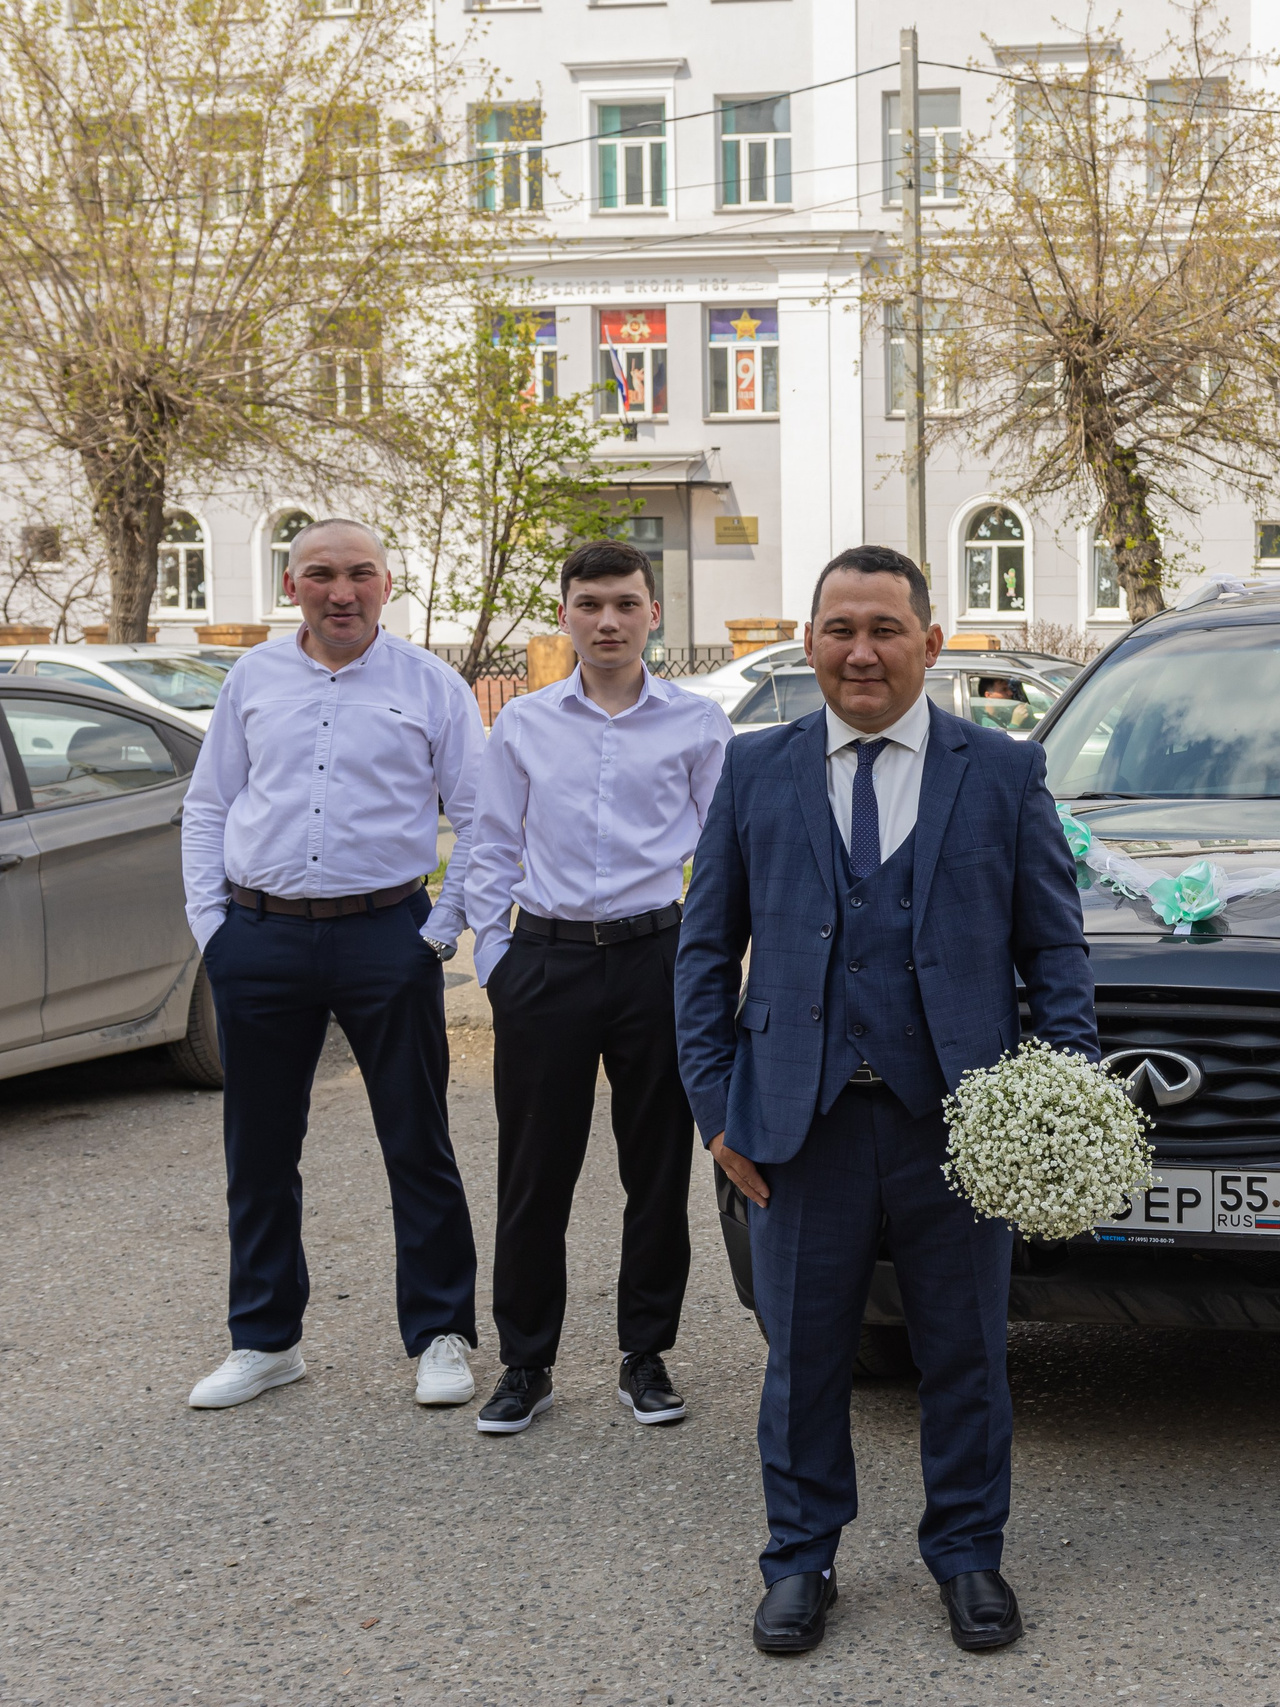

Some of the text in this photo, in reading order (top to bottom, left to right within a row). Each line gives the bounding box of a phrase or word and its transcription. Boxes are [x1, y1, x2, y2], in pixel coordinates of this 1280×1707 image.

[624, 277, 684, 294] ШКОЛА
[737, 358, 754, 389] 9
[1220, 1175, 1269, 1212] 55
[1217, 1213, 1253, 1228] RUS
